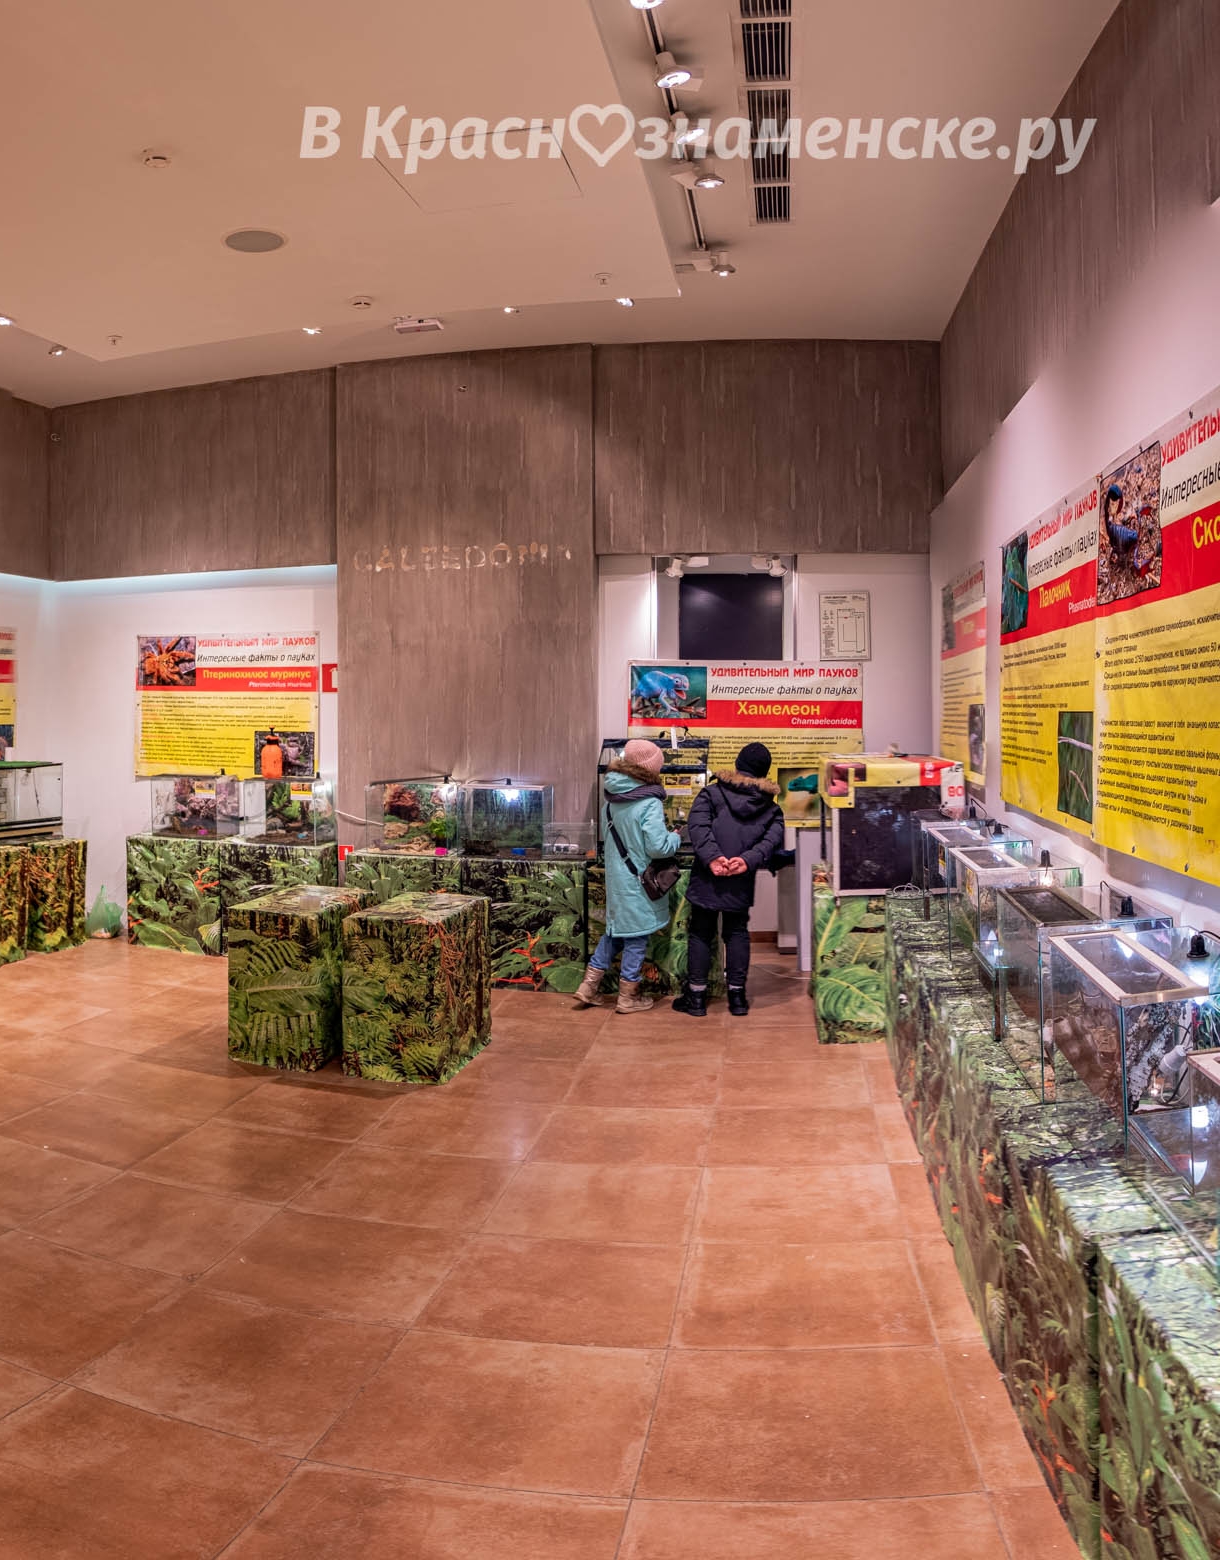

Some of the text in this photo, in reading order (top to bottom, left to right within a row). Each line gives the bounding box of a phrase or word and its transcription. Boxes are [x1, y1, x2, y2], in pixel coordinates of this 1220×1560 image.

[1039, 579, 1072, 608] Палочник
[282, 637, 316, 647] ПАУКОВ
[197, 653, 247, 663] Интересные
[248, 653, 278, 663] факты
[287, 652, 316, 664] пауках
[203, 669, 312, 681] Птеринохилюс муринус
[711, 667, 859, 678] УДИВИТЕЛЬНЫЙ МИР ПАУКОВ
[711, 684, 775, 696] Интересные
[777, 685, 813, 696] факты
[824, 685, 857, 697] пауках
[737, 701, 820, 715] Хамелеон
[791, 717, 858, 726] Chamaeleonidae
